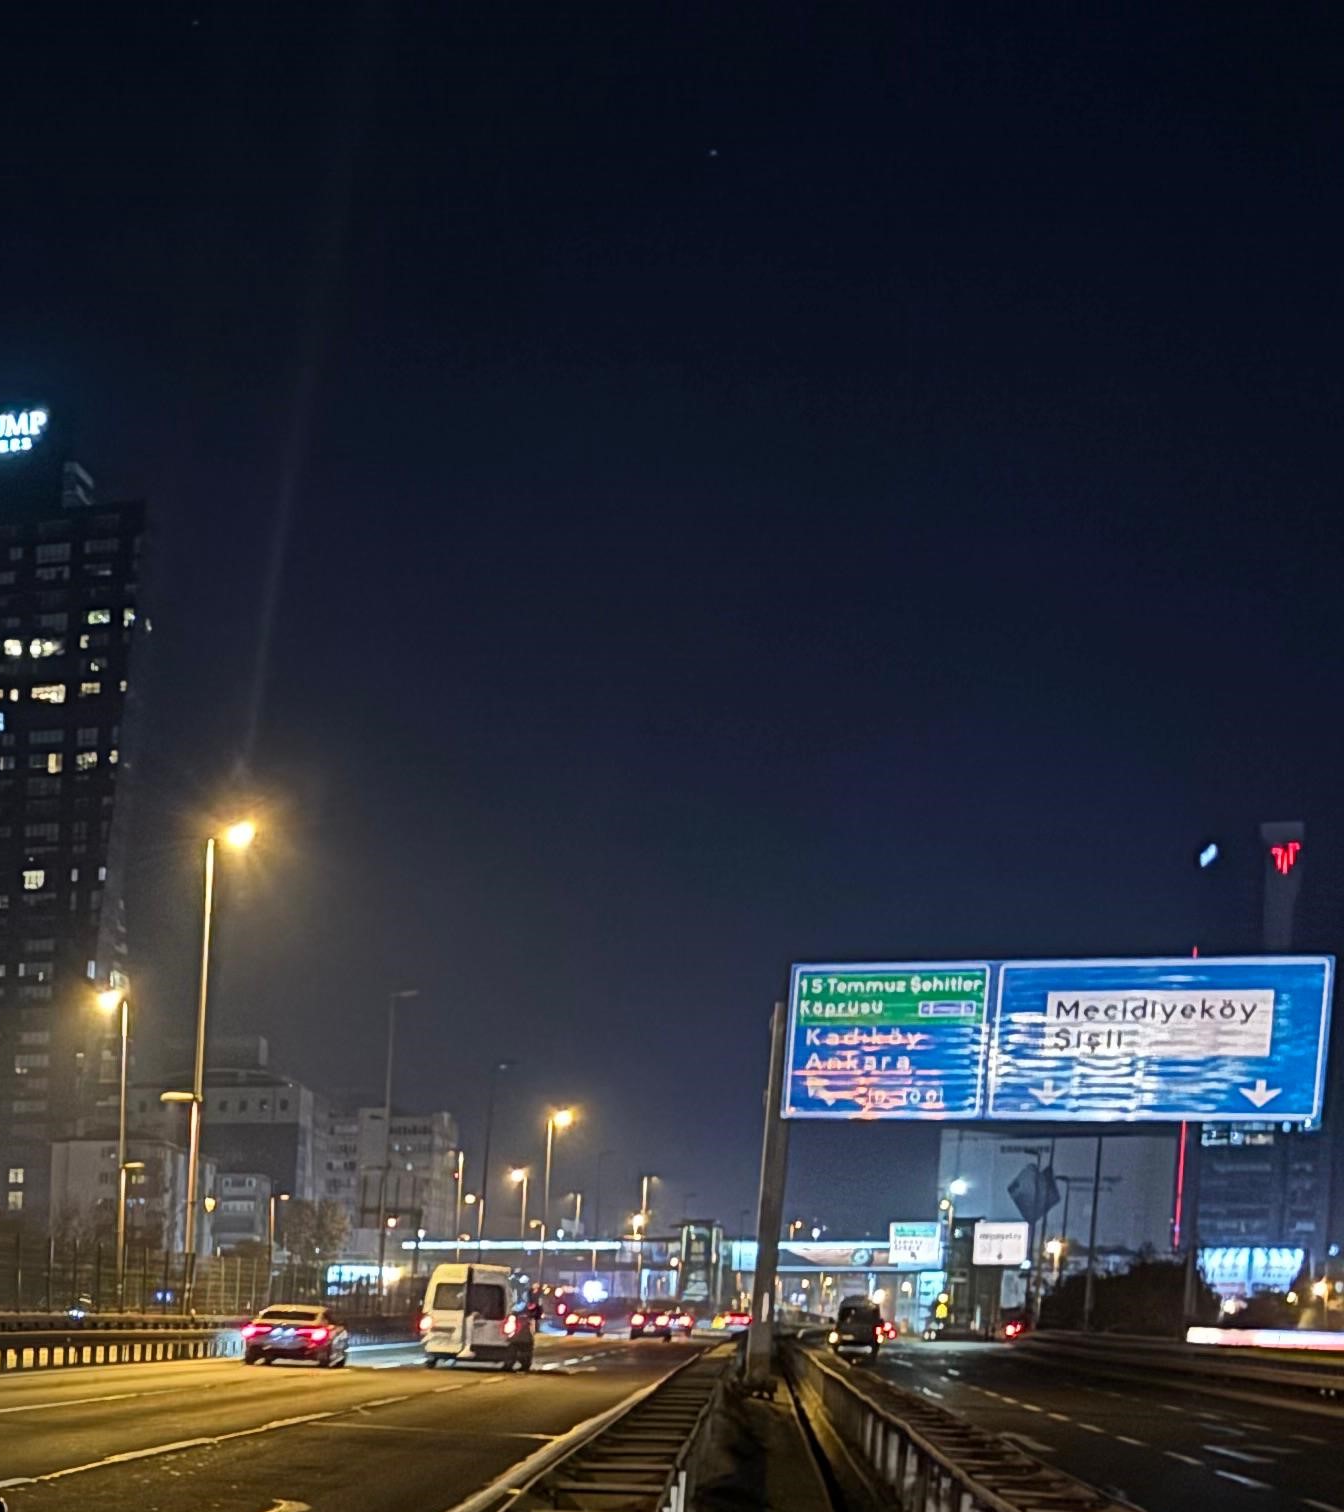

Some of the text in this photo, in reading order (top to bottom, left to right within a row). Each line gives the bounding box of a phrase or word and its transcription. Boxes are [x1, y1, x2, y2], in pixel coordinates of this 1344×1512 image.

[800, 976, 983, 996] 15 Temmuz Şehitler
[1056, 998, 1257, 1025] Mecidiyeköy
[1055, 1028, 1122, 1053] Şişli
[806, 1053, 911, 1071] Ankara
